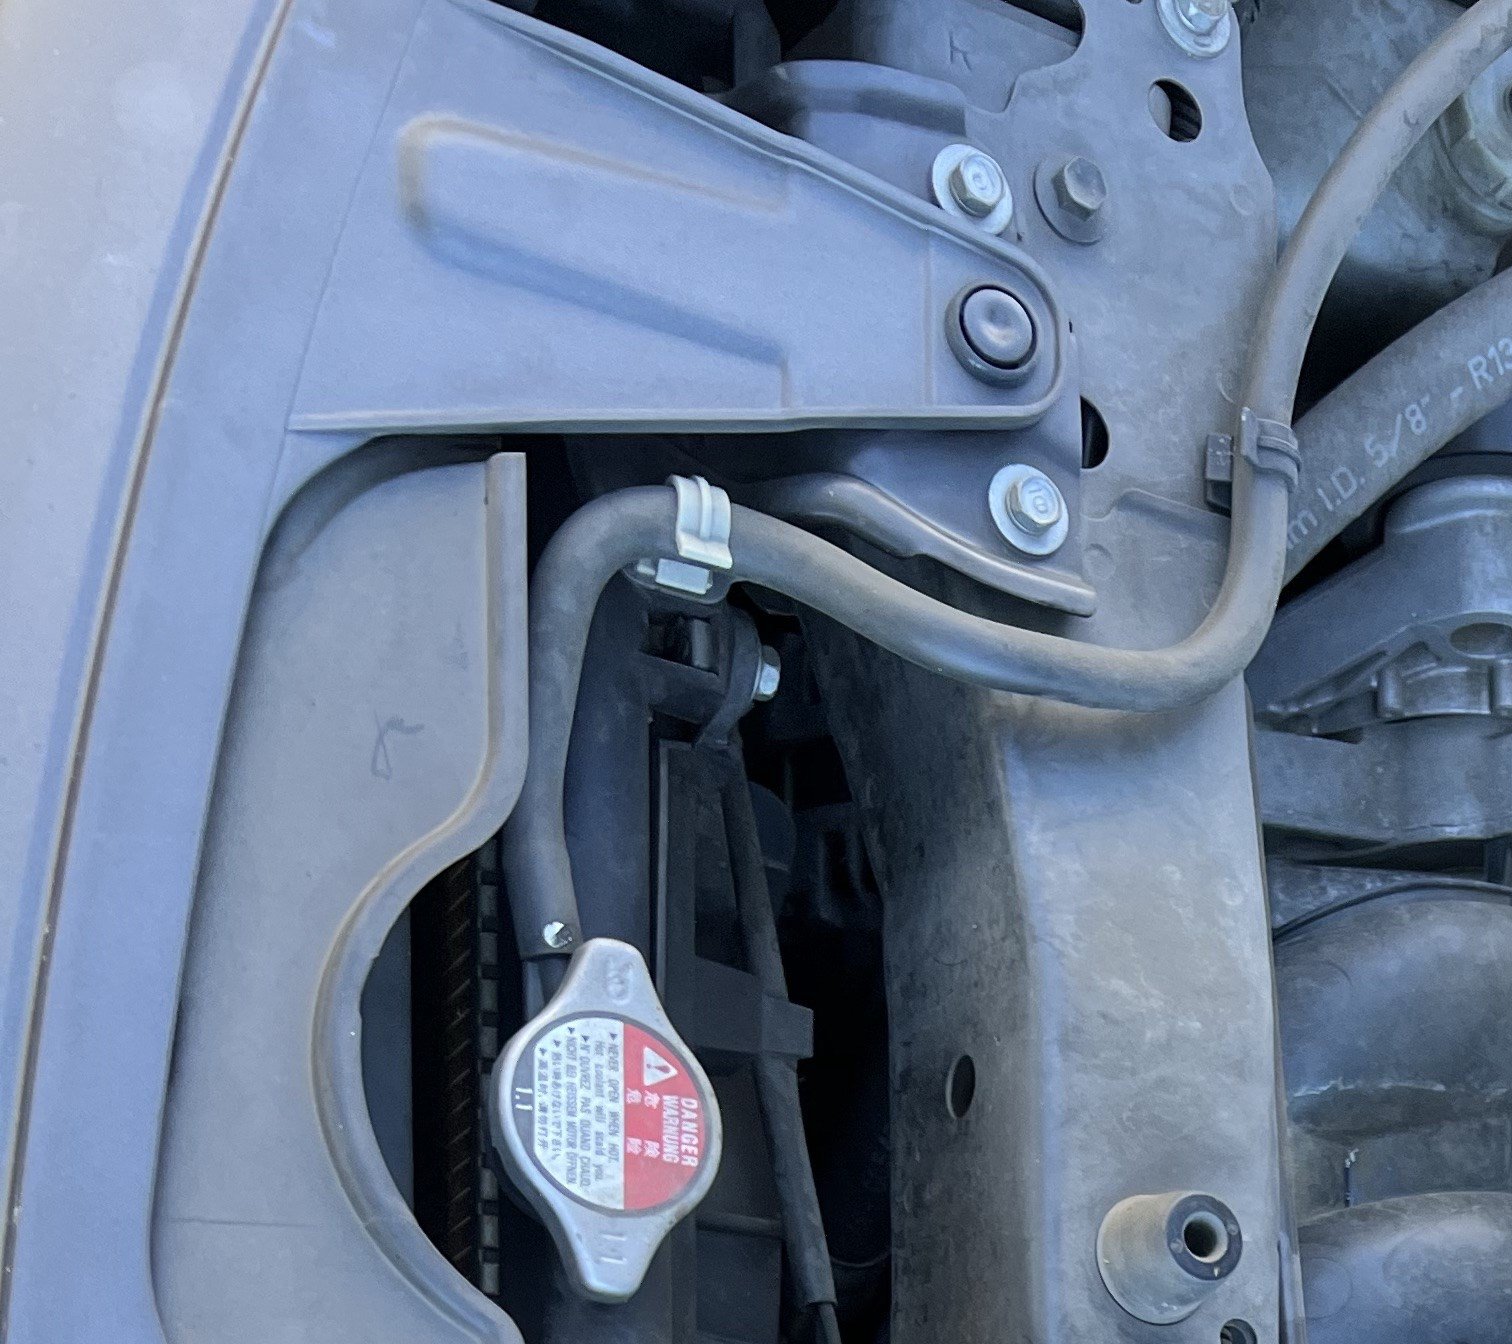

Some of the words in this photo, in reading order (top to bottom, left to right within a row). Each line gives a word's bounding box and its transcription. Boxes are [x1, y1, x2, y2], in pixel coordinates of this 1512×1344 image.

[565, 1035, 577, 1062] NICHT
[608, 1042, 619, 1071] NEVER
[514, 1086, 532, 1110] 1.1
[580, 1096, 590, 1113] PAS
[608, 1078, 619, 1103] OPEN
[565, 1120, 576, 1149] MOTOR
[579, 1119, 590, 1150] QUAND
[608, 1110, 619, 1136] WHEN
[661, 1094, 679, 1163] WARNUNG
[679, 1097, 698, 1166] DANGER
